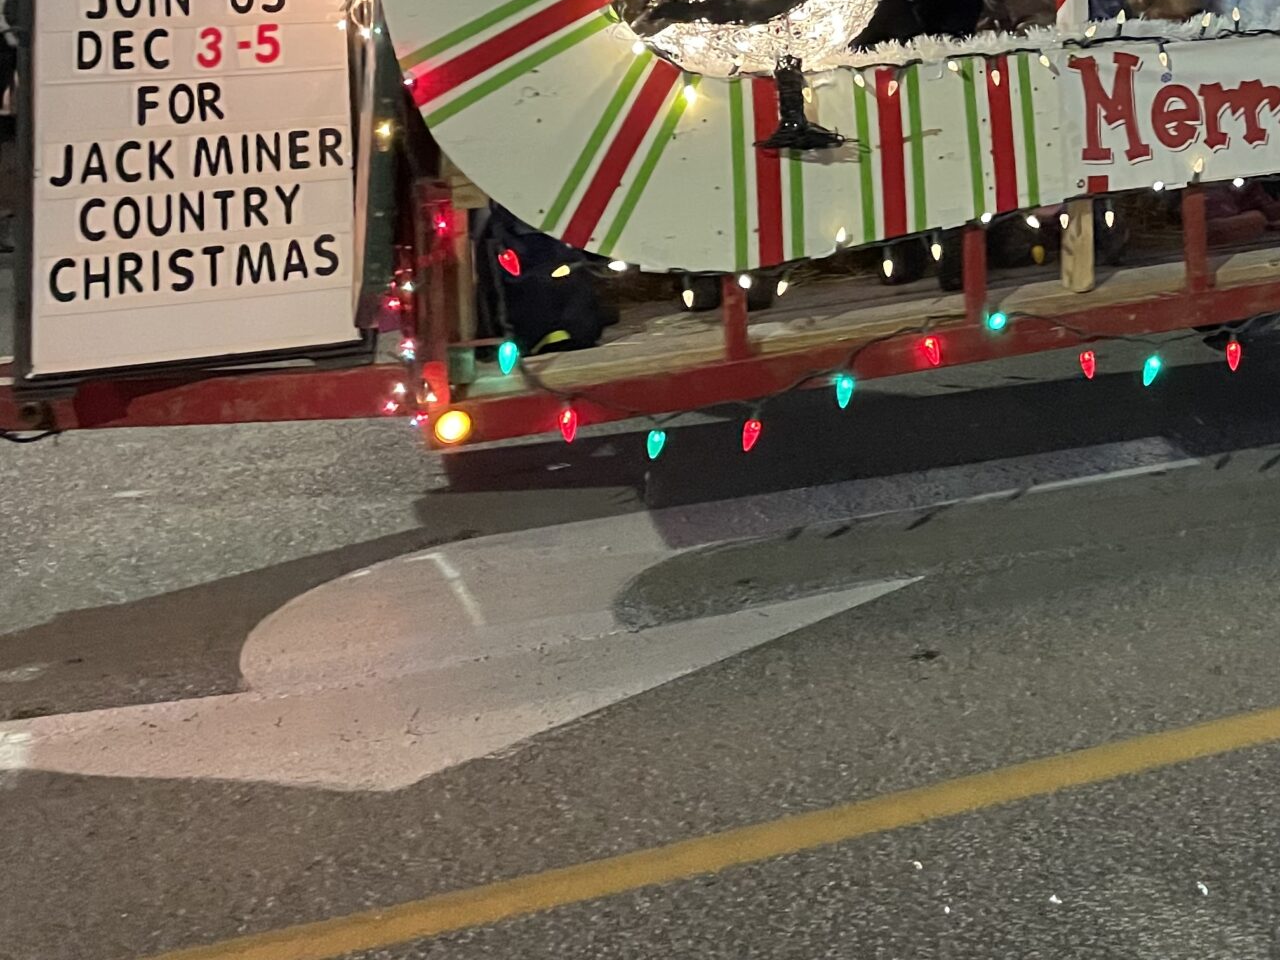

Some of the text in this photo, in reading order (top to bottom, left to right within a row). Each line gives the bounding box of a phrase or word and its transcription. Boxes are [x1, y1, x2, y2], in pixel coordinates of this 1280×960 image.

[77, 23, 281, 70] DEC 3-5
[137, 82, 225, 126] FOR
[49, 127, 344, 188] JACK MINER
[79, 184, 301, 242] COUNTRY
[49, 234, 340, 303] CHRISTMAS
